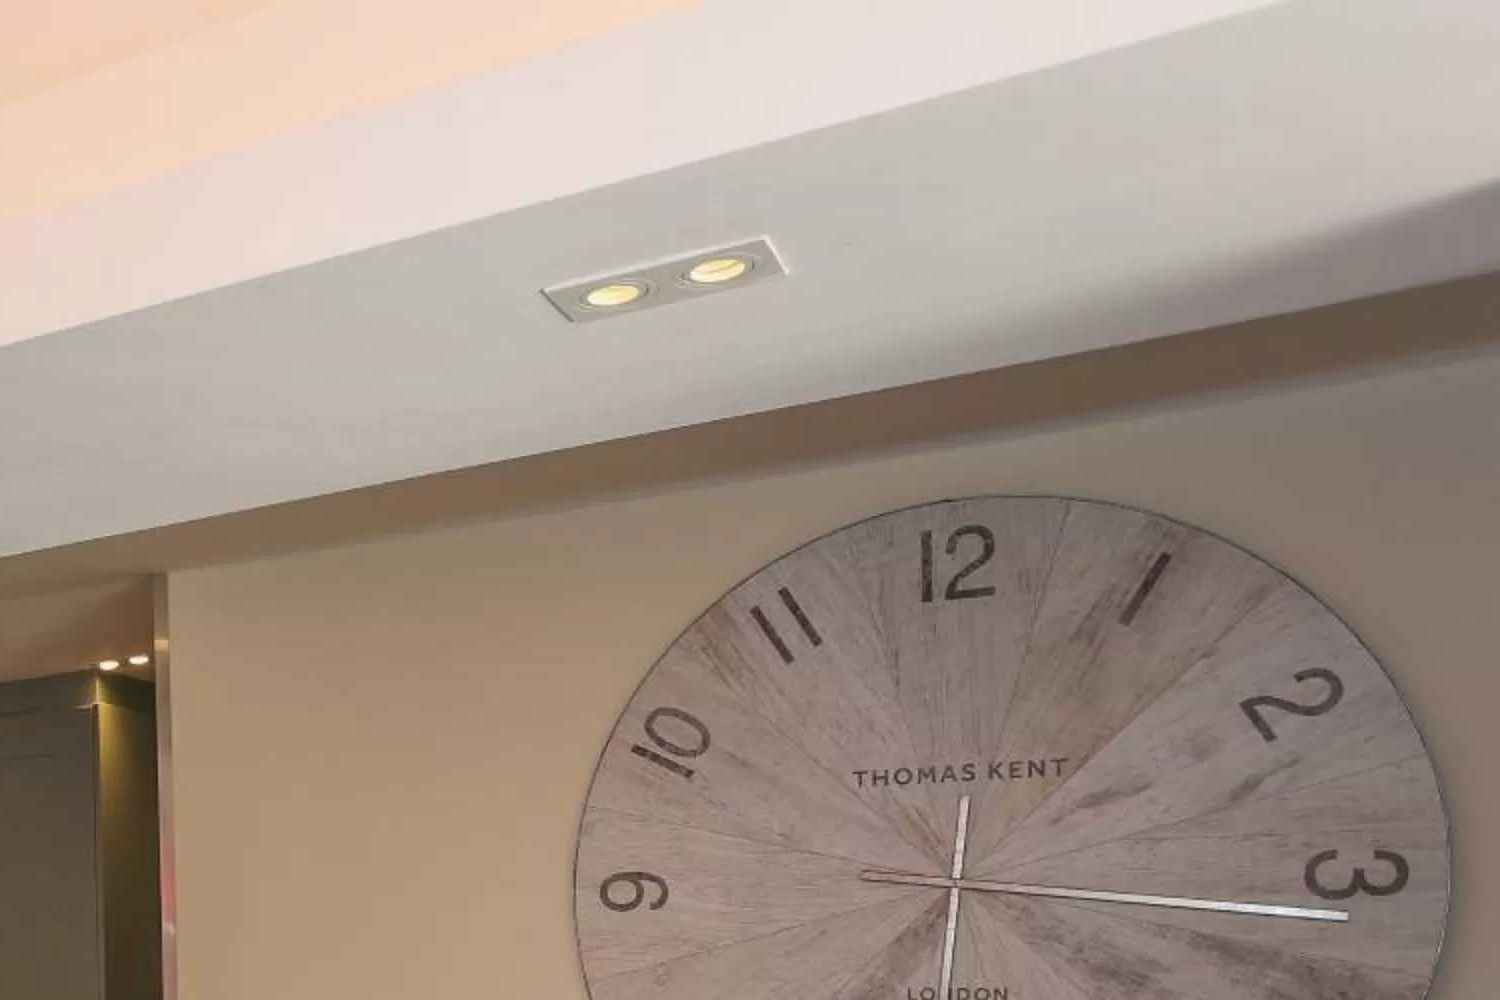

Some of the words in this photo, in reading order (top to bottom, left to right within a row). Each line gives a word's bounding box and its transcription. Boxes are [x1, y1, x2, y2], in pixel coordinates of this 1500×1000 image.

[920, 524, 996, 602] 12
[1119, 551, 1172, 626] 1
[750, 588, 822, 663] 11
[1240, 669, 1345, 741] 2
[631, 708, 712, 778] 10
[852, 763, 977, 788] THOMAS
[988, 758, 1069, 781] KENT
[600, 870, 668, 914] 9
[1305, 850, 1409, 901] 3
